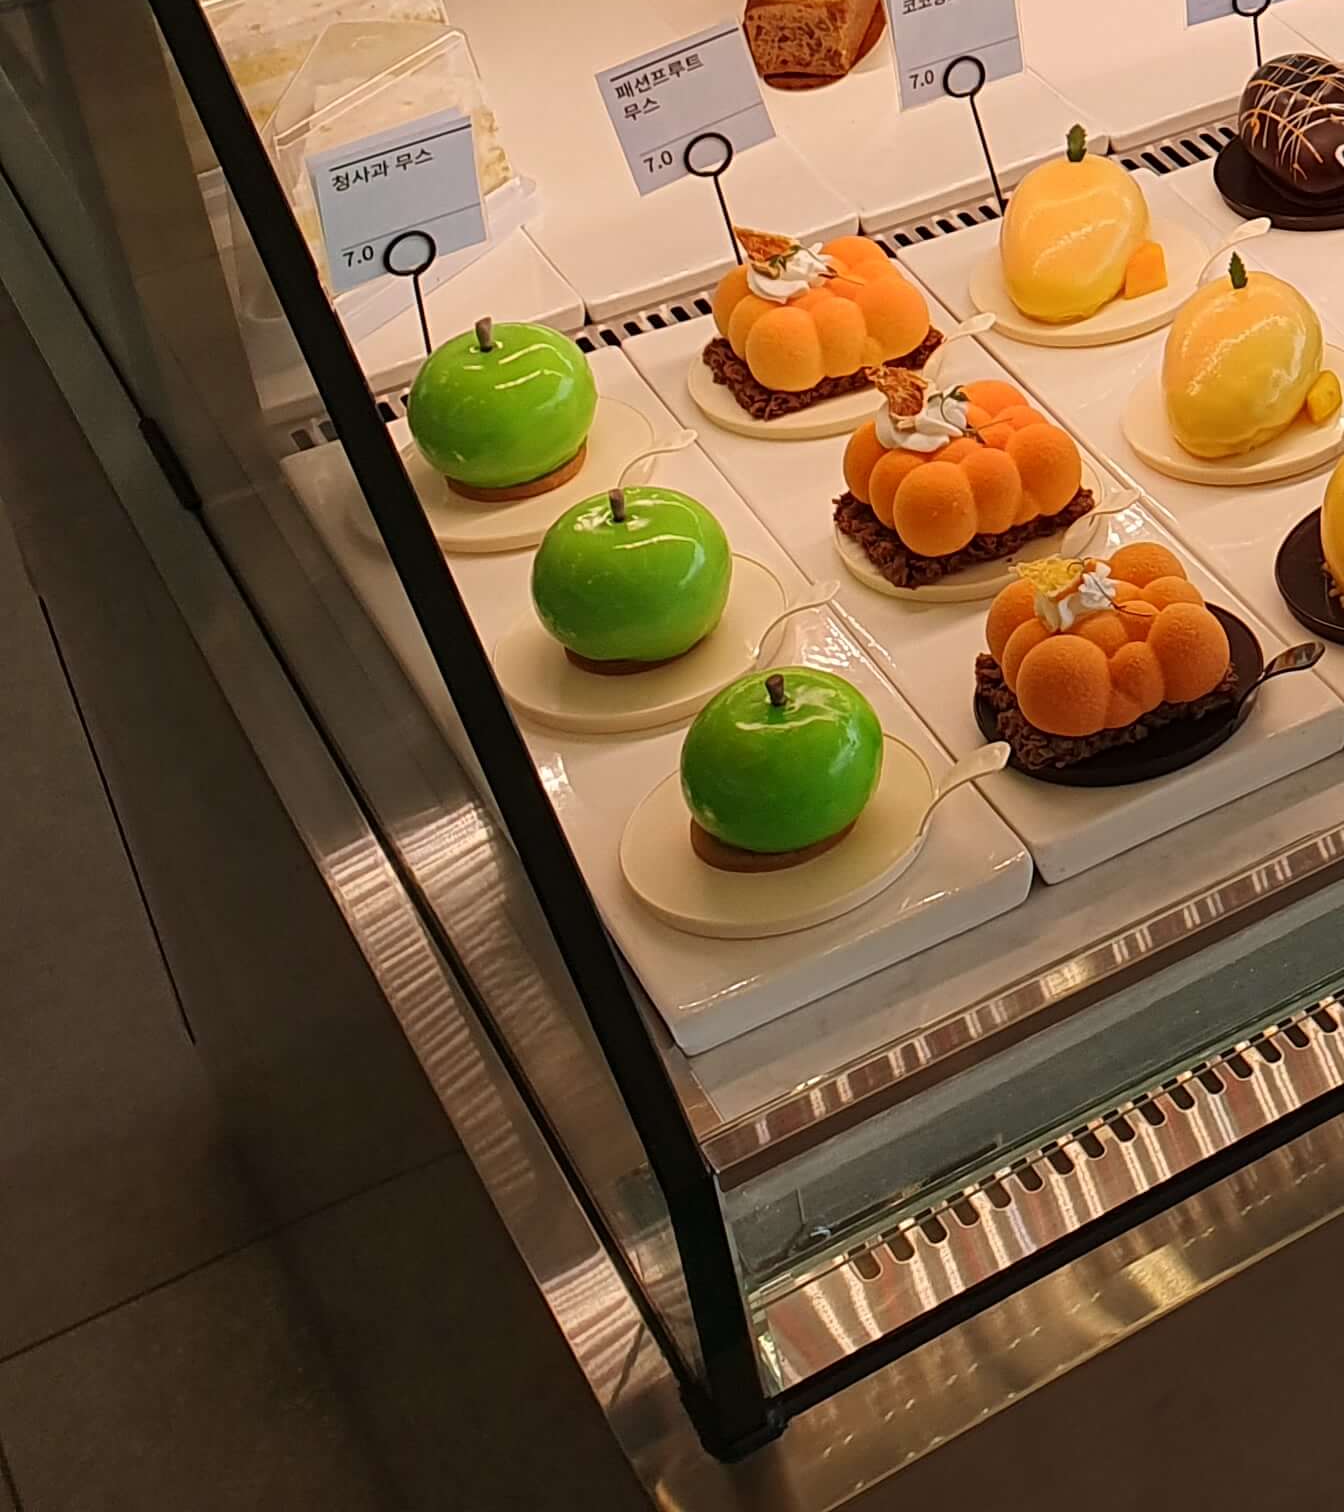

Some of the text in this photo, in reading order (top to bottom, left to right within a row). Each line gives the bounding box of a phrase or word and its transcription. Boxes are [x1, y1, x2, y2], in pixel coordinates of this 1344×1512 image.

[614, 53, 704, 99] 패션프루트
[909, 69, 935, 90] 7.0
[624, 97, 660, 121] 무스
[332, 148, 433, 192] 청사과 무스
[643, 150, 673, 173] 7.0
[342, 245, 374, 267] 7.0
